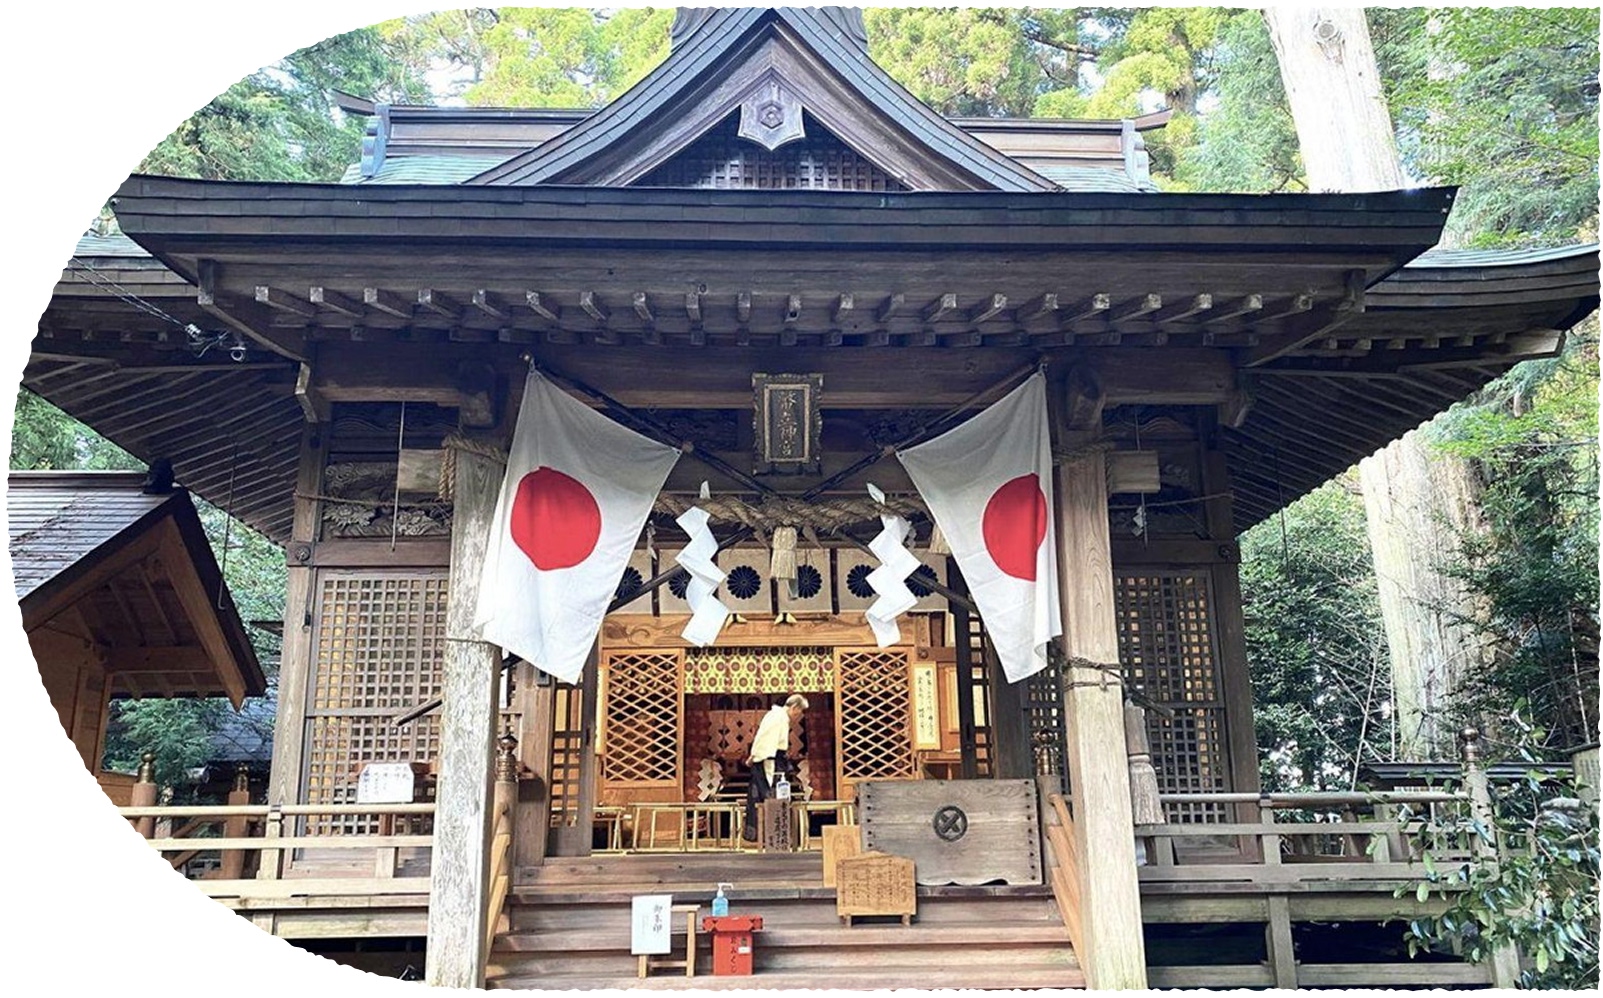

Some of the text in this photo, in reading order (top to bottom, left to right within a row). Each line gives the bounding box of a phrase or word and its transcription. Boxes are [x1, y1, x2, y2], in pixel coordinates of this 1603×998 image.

[653, 905, 663, 933] 御朱印
[729, 935, 738, 974] おみくじ
